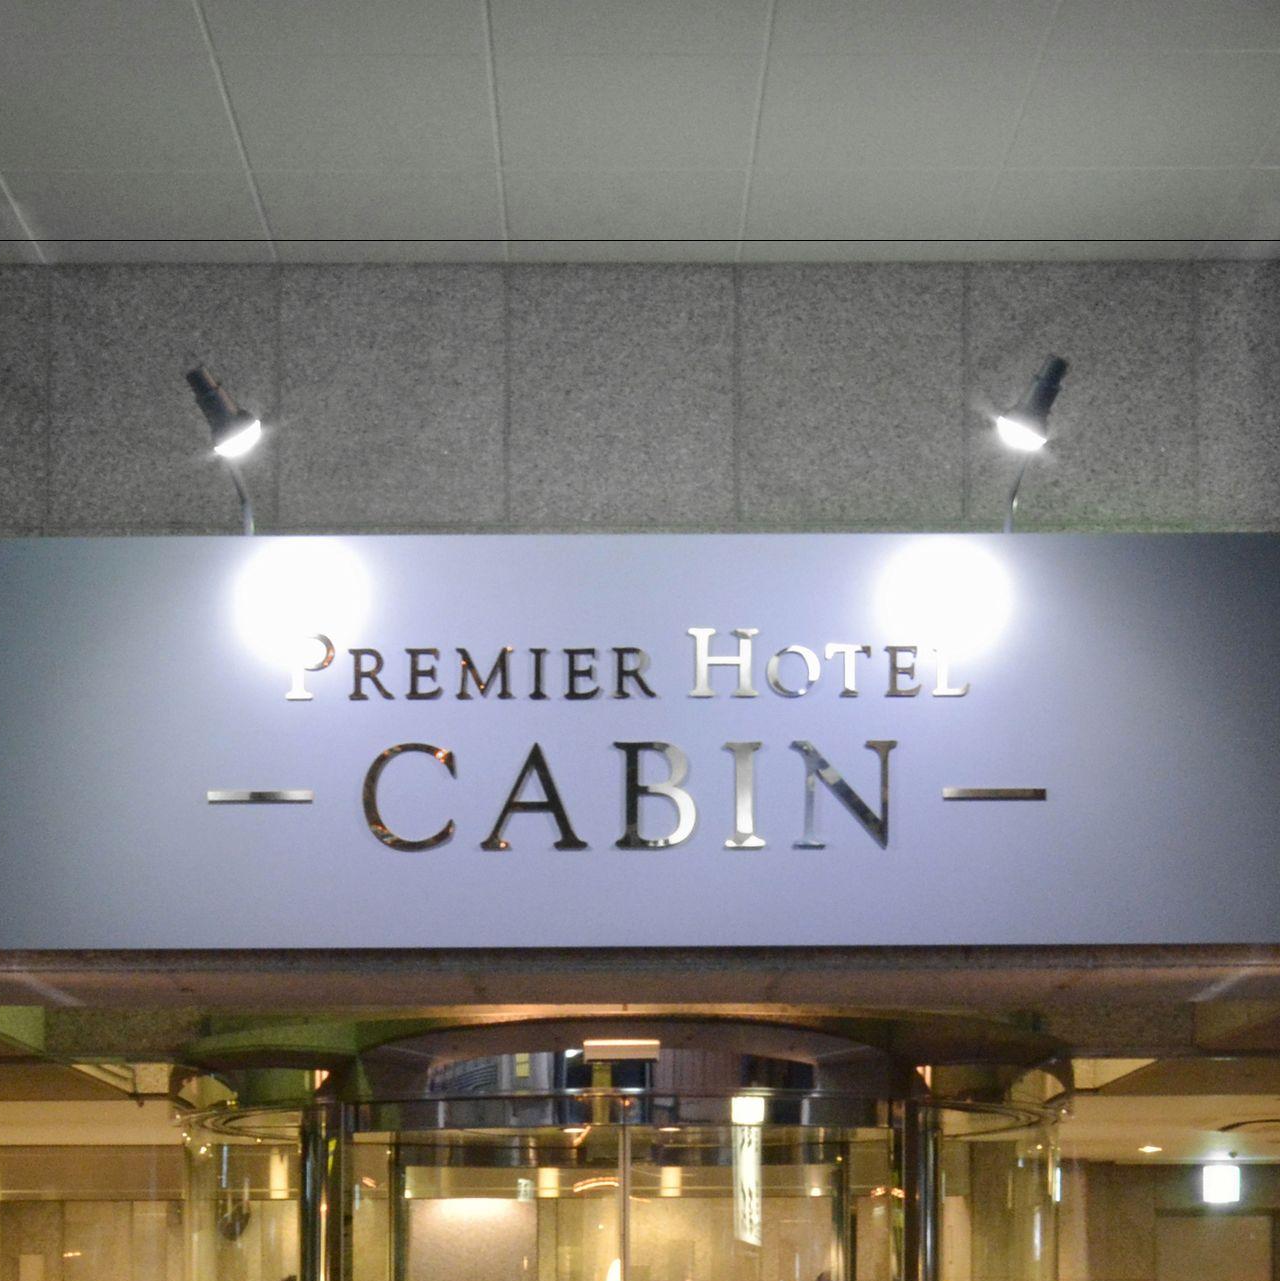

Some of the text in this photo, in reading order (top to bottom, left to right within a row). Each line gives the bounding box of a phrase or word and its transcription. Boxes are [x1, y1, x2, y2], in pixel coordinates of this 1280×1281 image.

[285, 627, 971, 701] PREMIER HOTEL
[360, 740, 900, 852] CABIN
